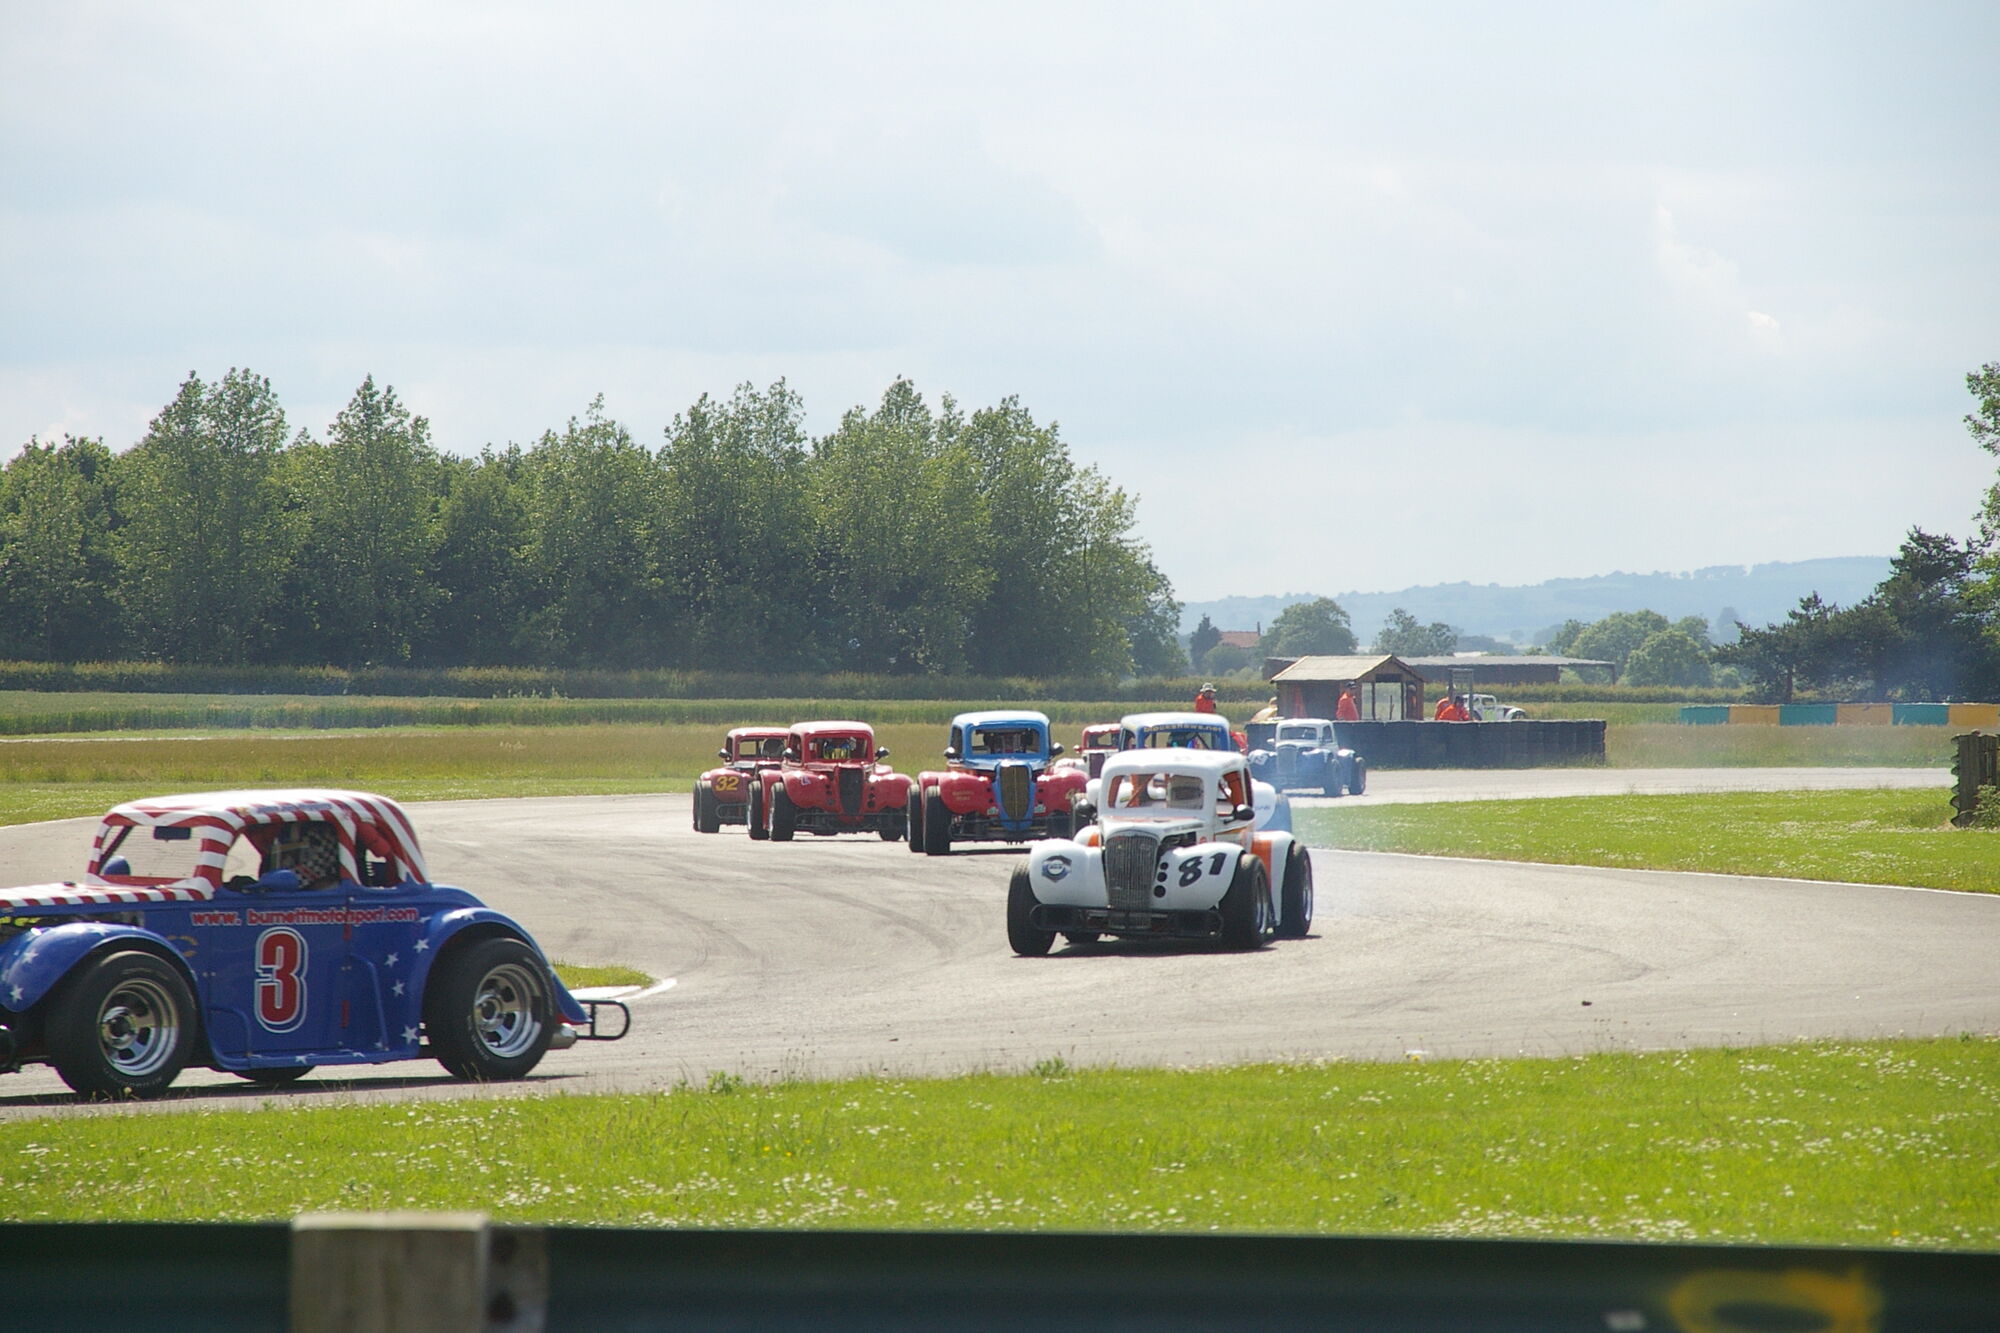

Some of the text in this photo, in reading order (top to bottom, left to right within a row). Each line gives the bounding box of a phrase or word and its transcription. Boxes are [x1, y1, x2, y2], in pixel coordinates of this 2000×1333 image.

[715, 776, 739, 791] 32
[1178, 852, 1227, 887] 81
[254, 926, 309, 1034] 3
